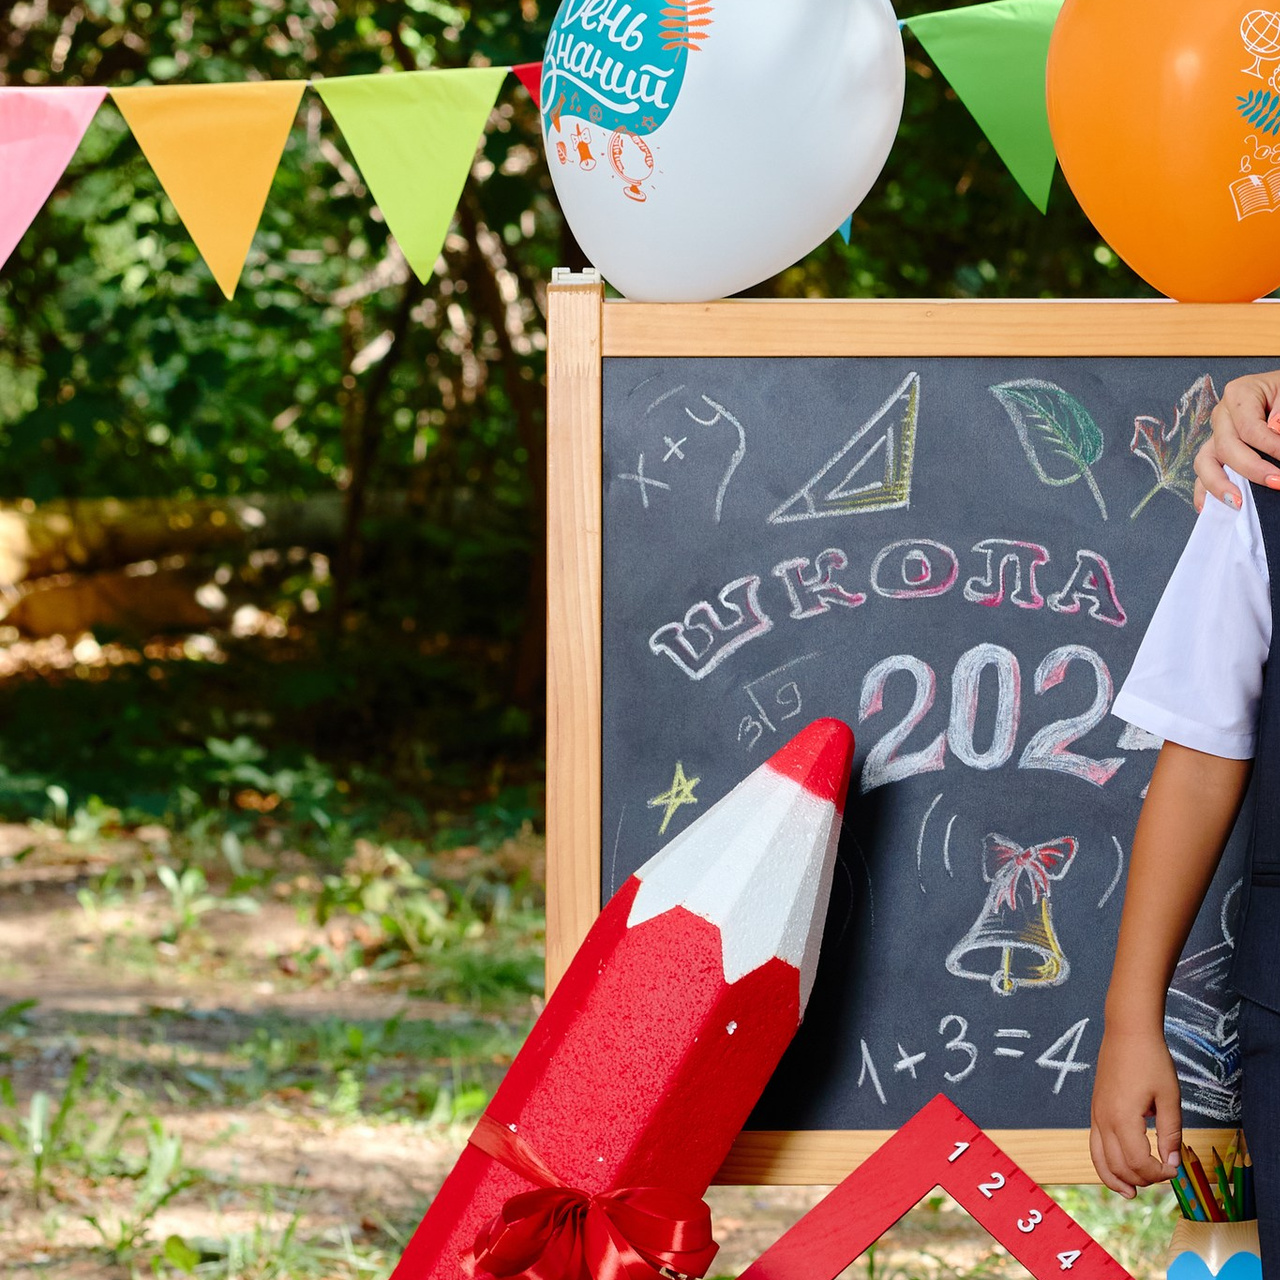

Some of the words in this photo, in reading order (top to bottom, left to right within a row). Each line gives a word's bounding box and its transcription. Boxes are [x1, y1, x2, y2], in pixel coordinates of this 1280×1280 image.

[541, 30, 670, 114] знаний
[649, 538, 1127, 680] ШКОЛА
[858, 642, 1165, 798] 202
[947, 1141, 970, 1162] 1
[977, 1172, 1006, 1199] 2
[1017, 1209, 1043, 1233] 3
[1056, 1249, 1082, 1271] 4
